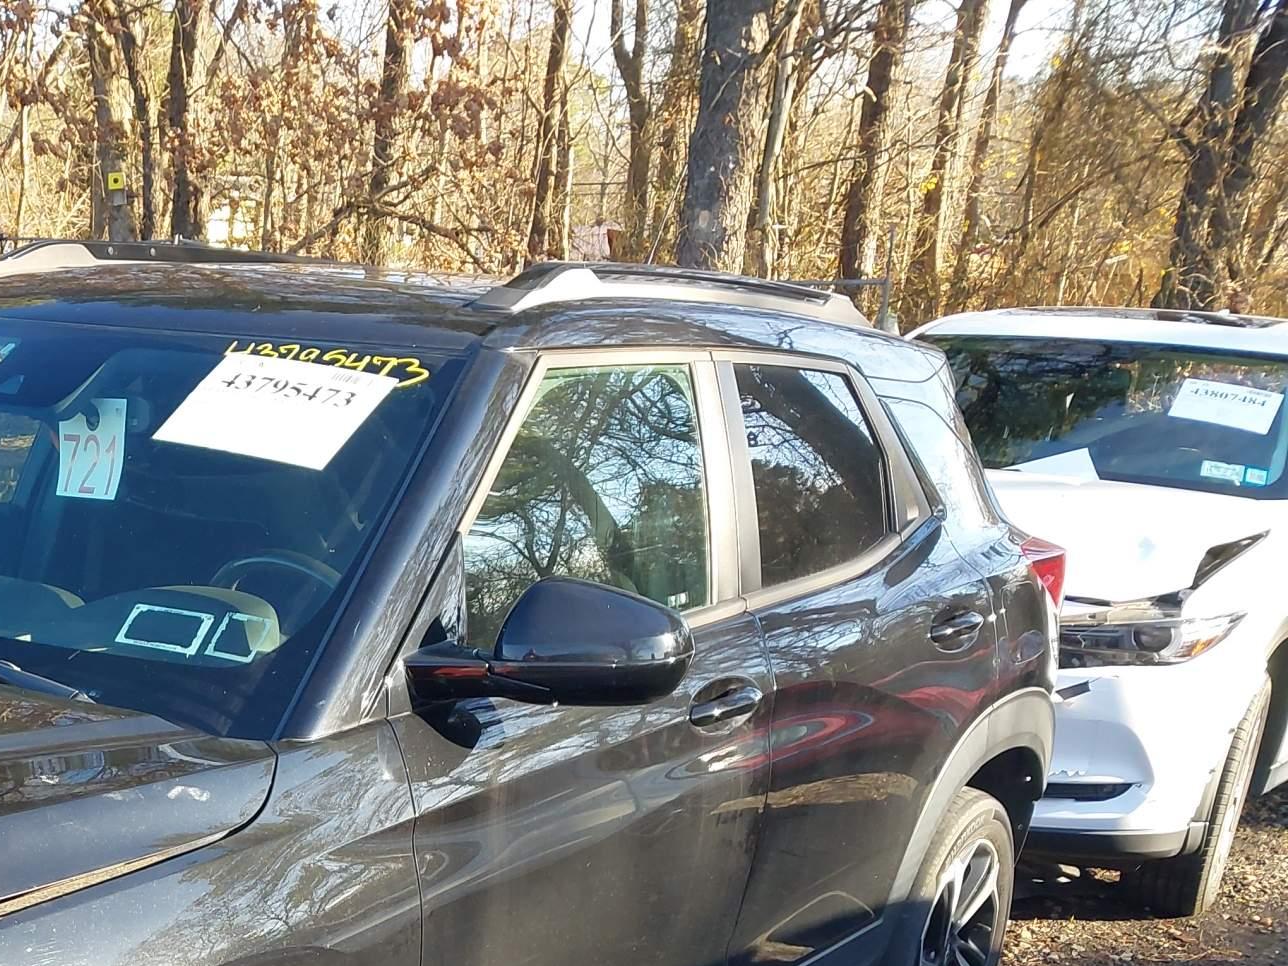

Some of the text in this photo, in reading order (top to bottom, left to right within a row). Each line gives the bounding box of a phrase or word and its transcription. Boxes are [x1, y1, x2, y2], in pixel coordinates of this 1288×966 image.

[221, 372, 357, 407] 43795473
[1189, 387, 1268, 407] 43807484
[63, 433, 117, 496] 721
